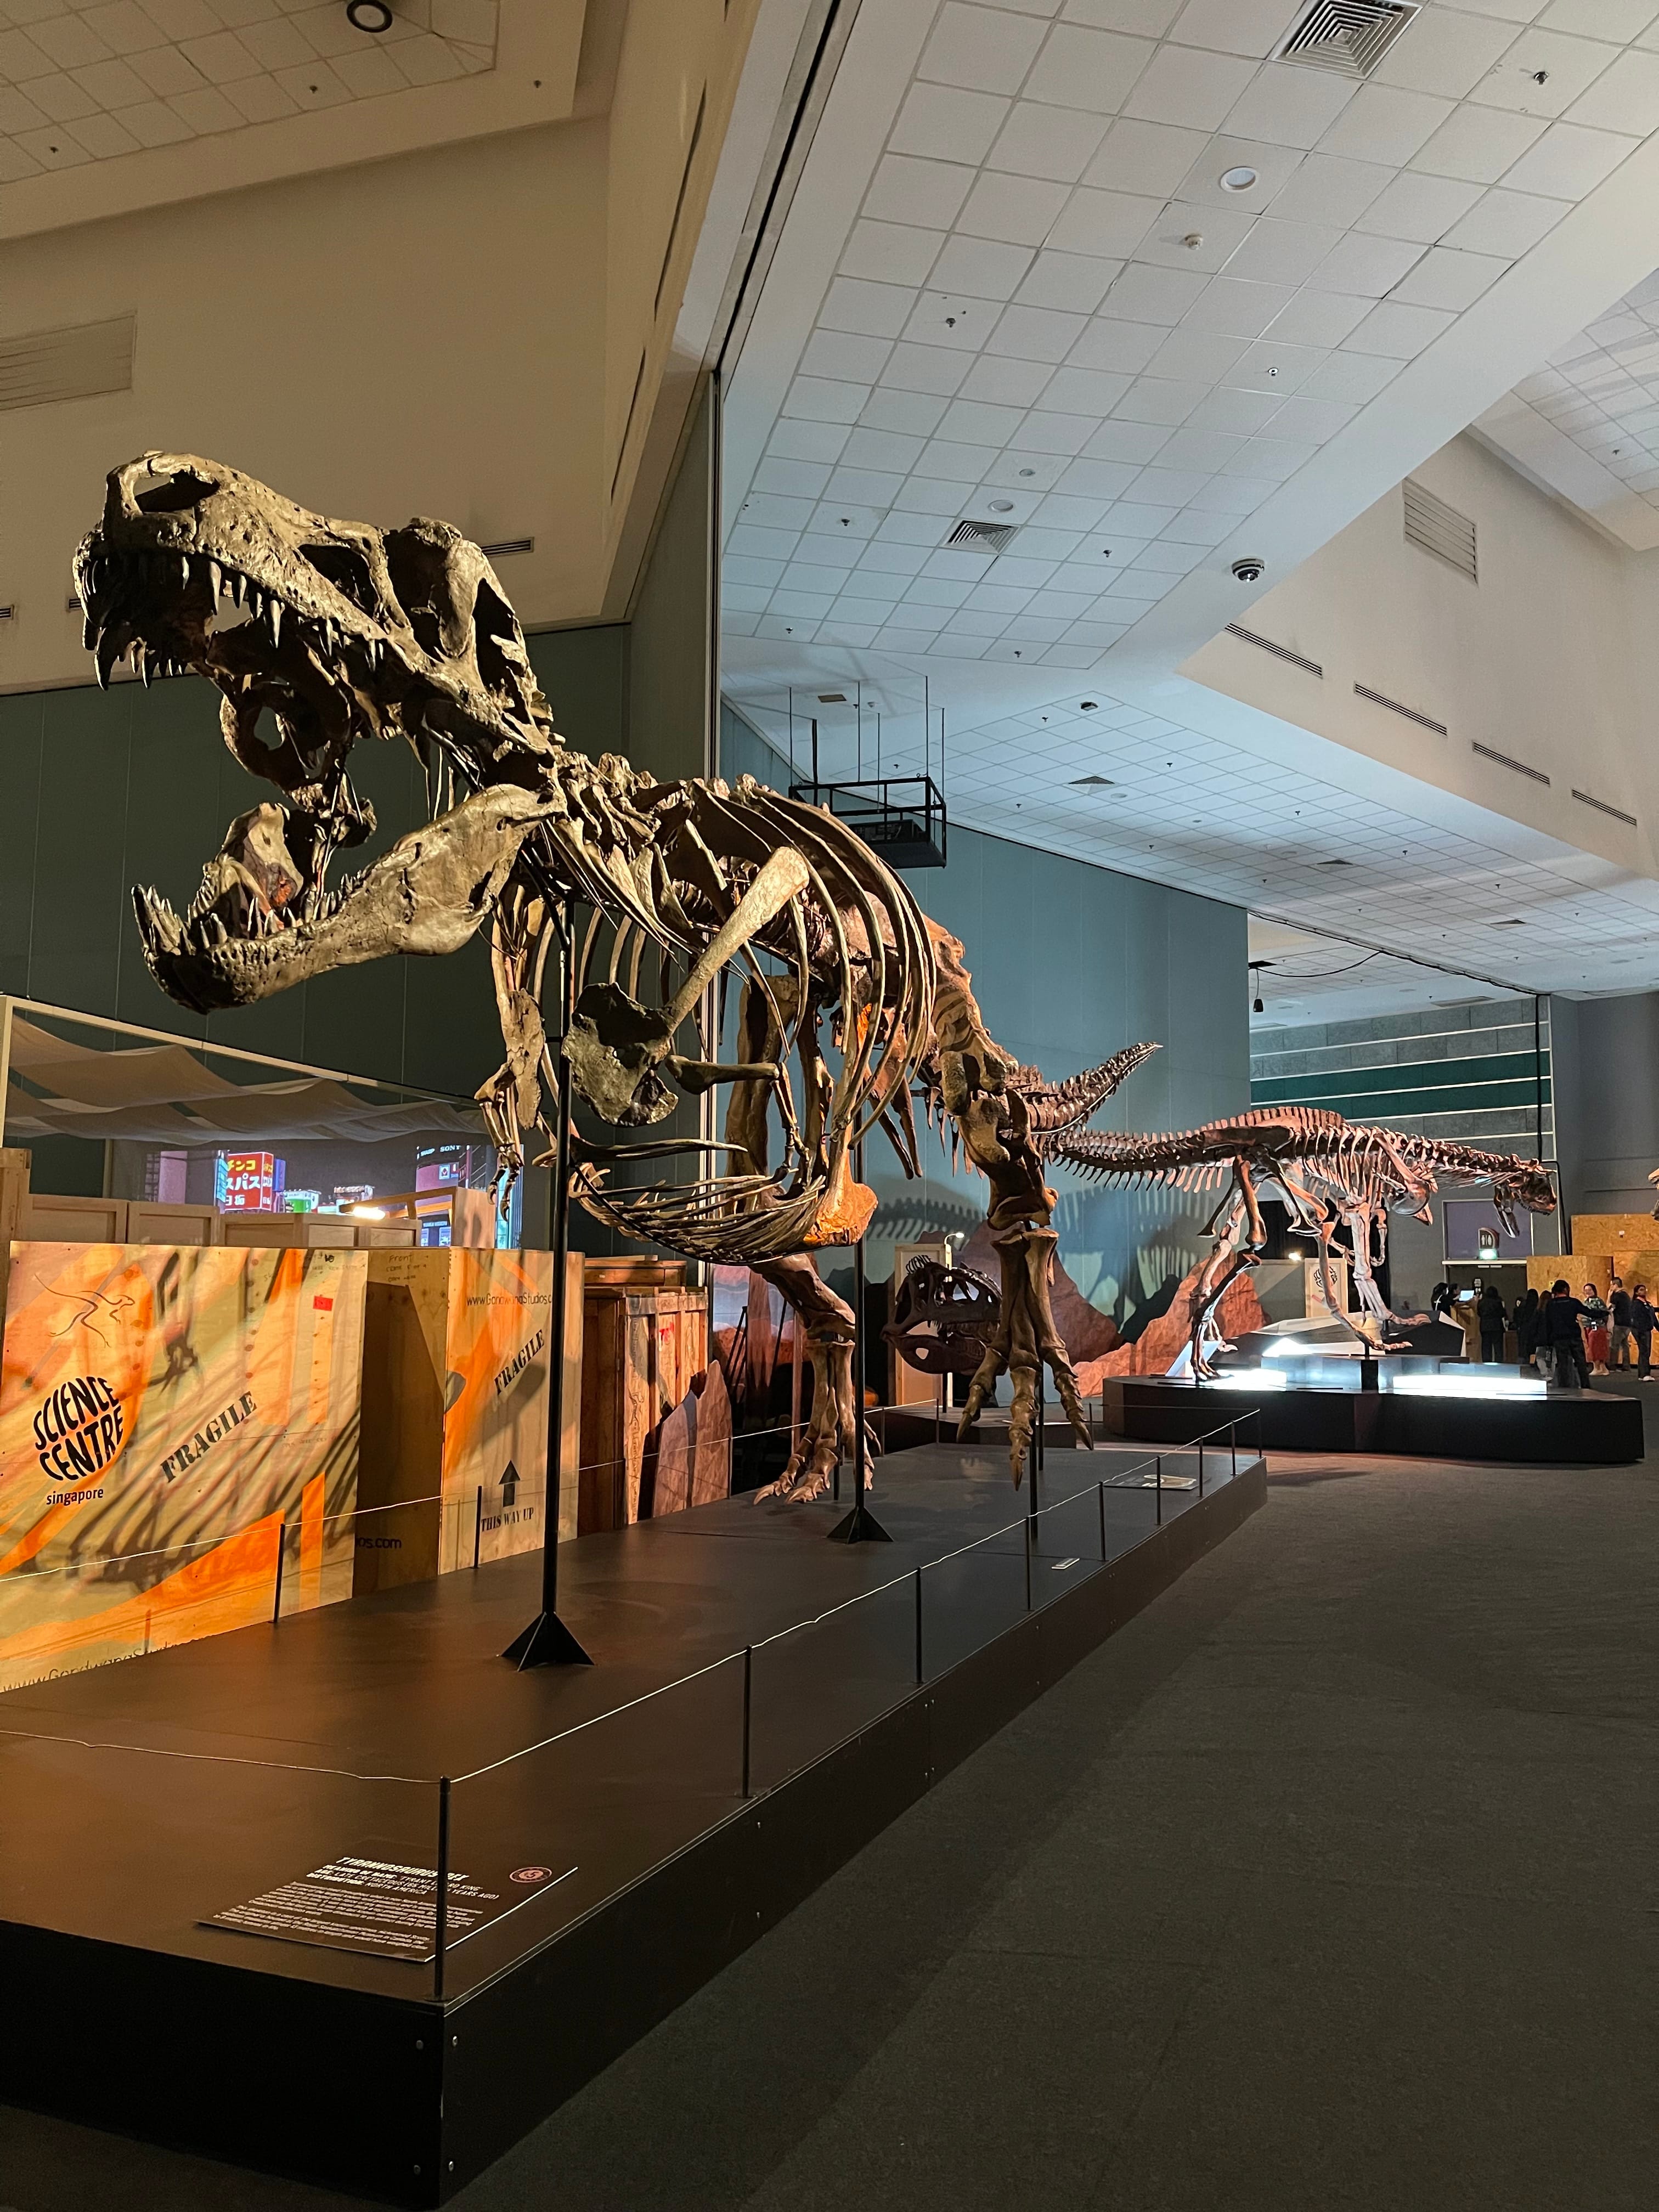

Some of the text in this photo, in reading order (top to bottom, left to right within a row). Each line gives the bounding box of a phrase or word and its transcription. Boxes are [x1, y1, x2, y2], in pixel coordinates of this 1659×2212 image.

[227, 1159, 256, 1171] チンコ
[225, 1172, 261, 1190] スパス
[494, 1329, 544, 1396] FRAGILE
[33, 1376, 119, 1450] SCIENCE
[40, 1405, 123, 1481] CENTRE
[160, 1391, 257, 1483] FRAGILE
[46, 1488, 104, 1506] singapore
[481, 1507, 534, 1532] THIS WAY UP
[322, 1864, 361, 1873] MEANING
[431, 1879, 460, 1888] LRD
[336, 1857, 438, 1877] TYRANNOSAURUS
[306, 1872, 365, 1886] DISTRIBUTION:
[392, 1886, 428, 1895] AMERICA
[354, 1875, 405, 1886] CRETACEOUS
[452, 1888, 478, 1897] YEARS
